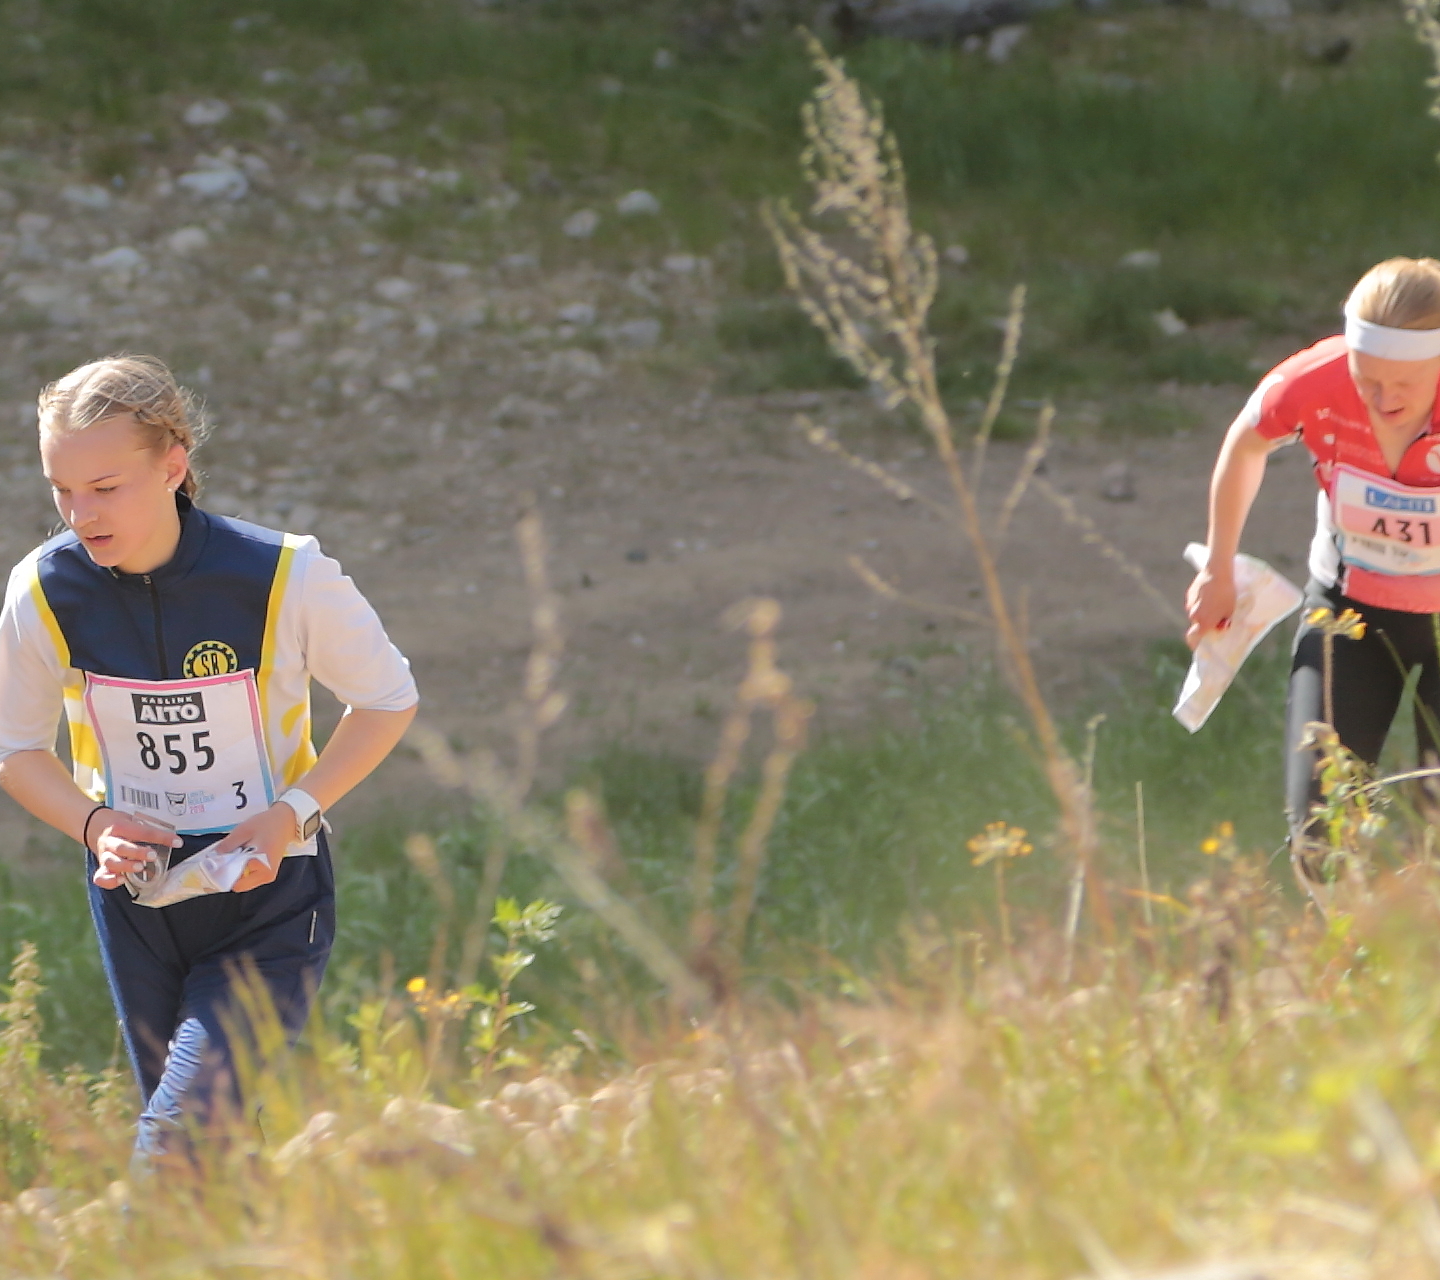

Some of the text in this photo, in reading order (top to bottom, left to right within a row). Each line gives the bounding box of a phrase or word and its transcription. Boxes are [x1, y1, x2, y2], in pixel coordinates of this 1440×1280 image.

[1371, 518, 1431, 545] 431
[140, 703, 200, 723] AITO
[136, 731, 215, 775] 855
[232, 780, 248, 810] 3
